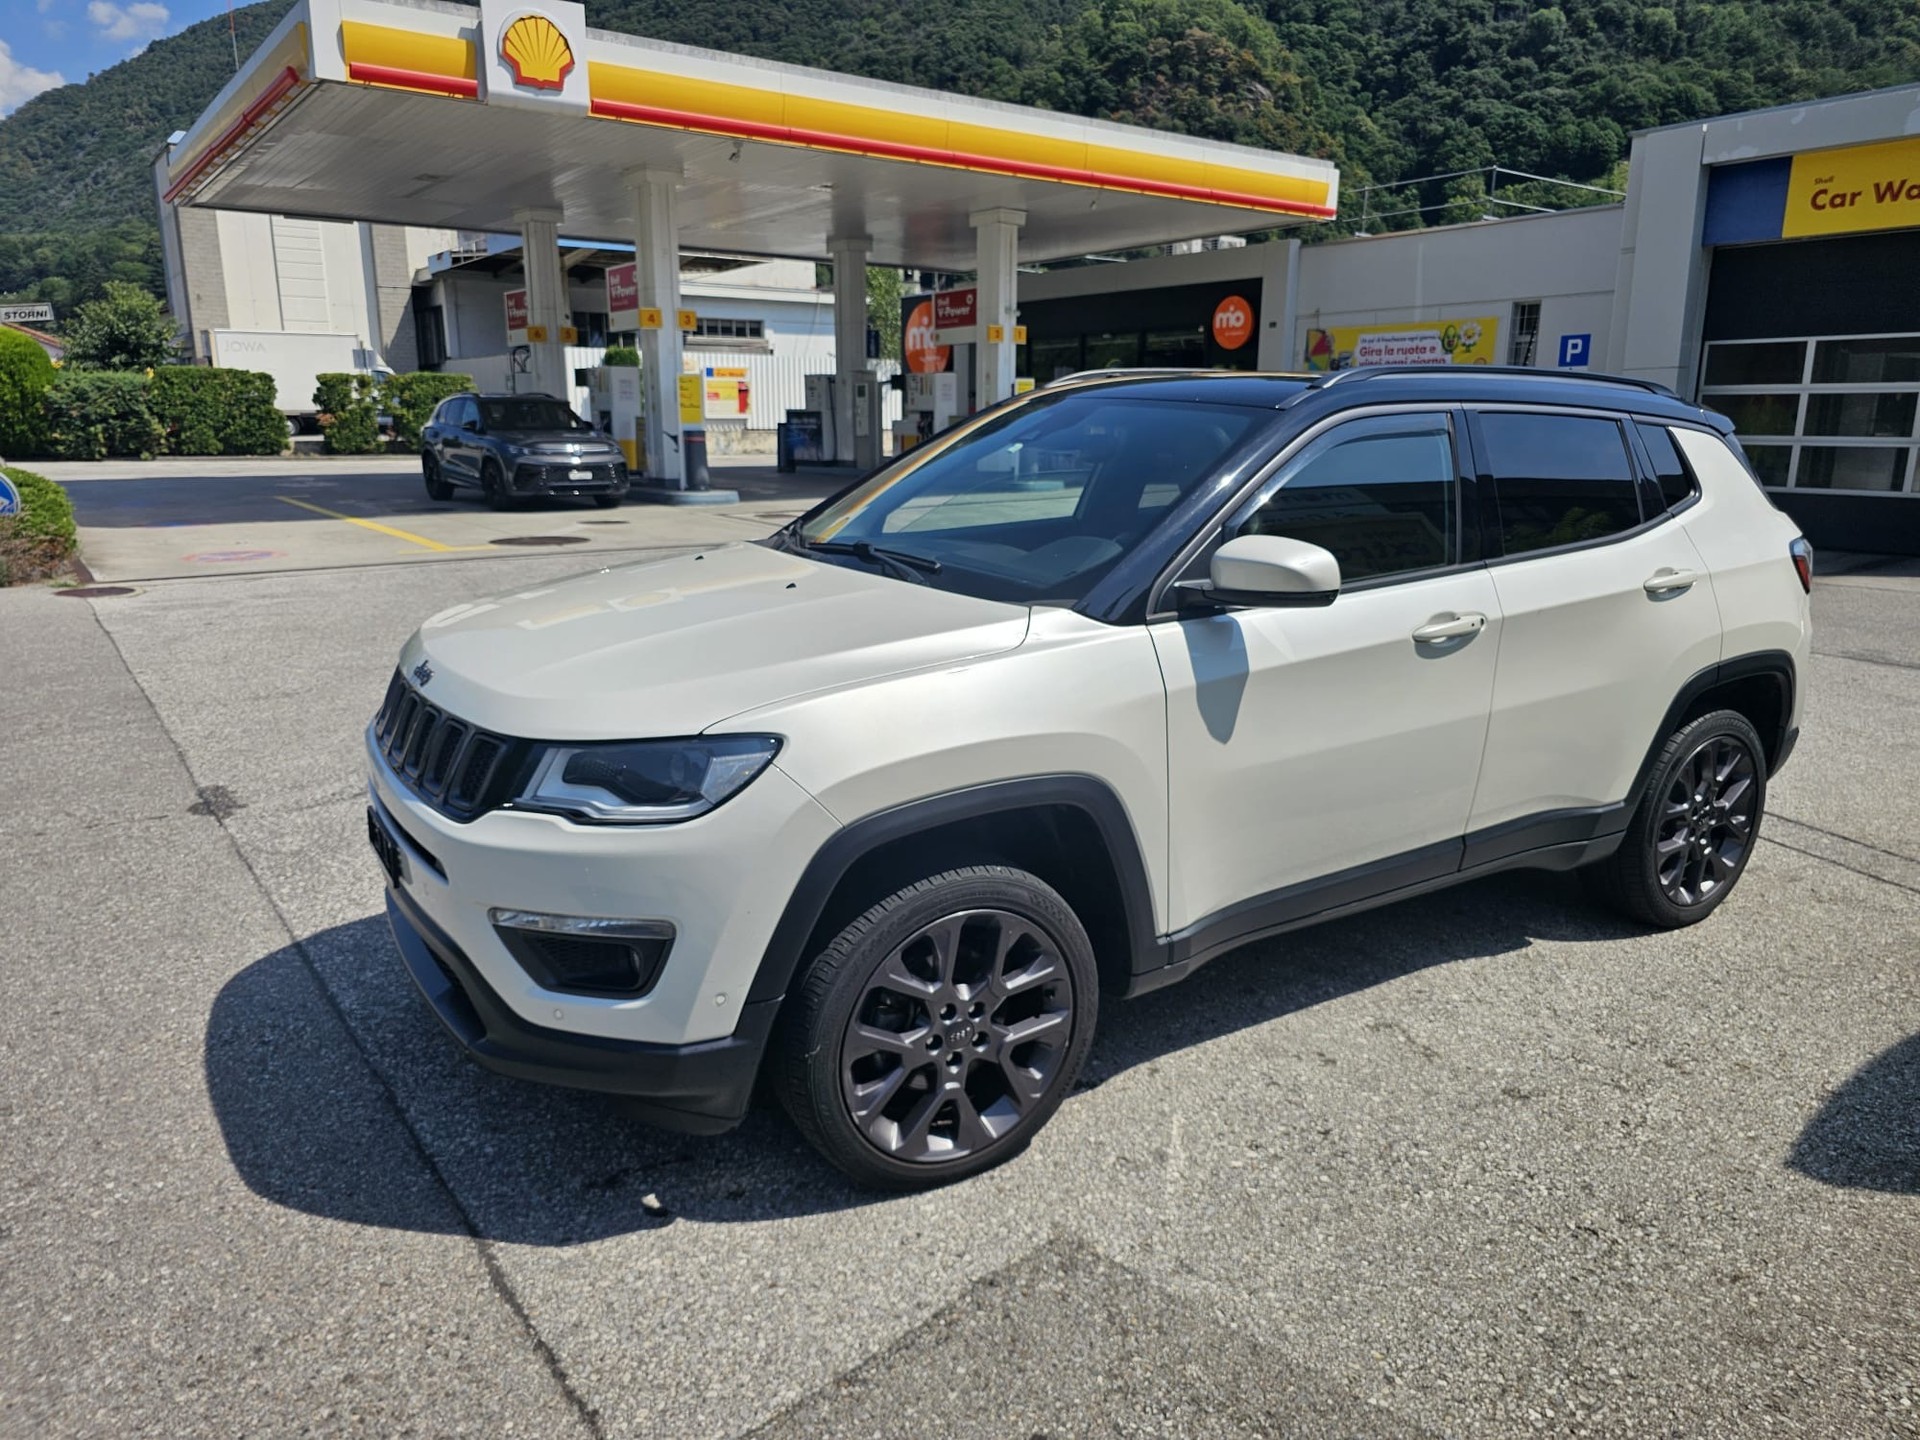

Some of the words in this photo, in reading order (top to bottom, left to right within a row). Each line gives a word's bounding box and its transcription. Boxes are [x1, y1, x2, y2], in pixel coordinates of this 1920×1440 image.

[1810, 188, 1863, 211] Car
[1873, 178, 1920, 204] Wa
[4, 310, 48, 320] STORNI
[1215, 304, 1246, 329] mio
[1359, 346, 1382, 357] Gira
[1384, 345, 1394, 356] la
[1396, 345, 1427, 355] ruota
[1429, 346, 1436, 354] e
[1566, 339, 1582, 362] P
